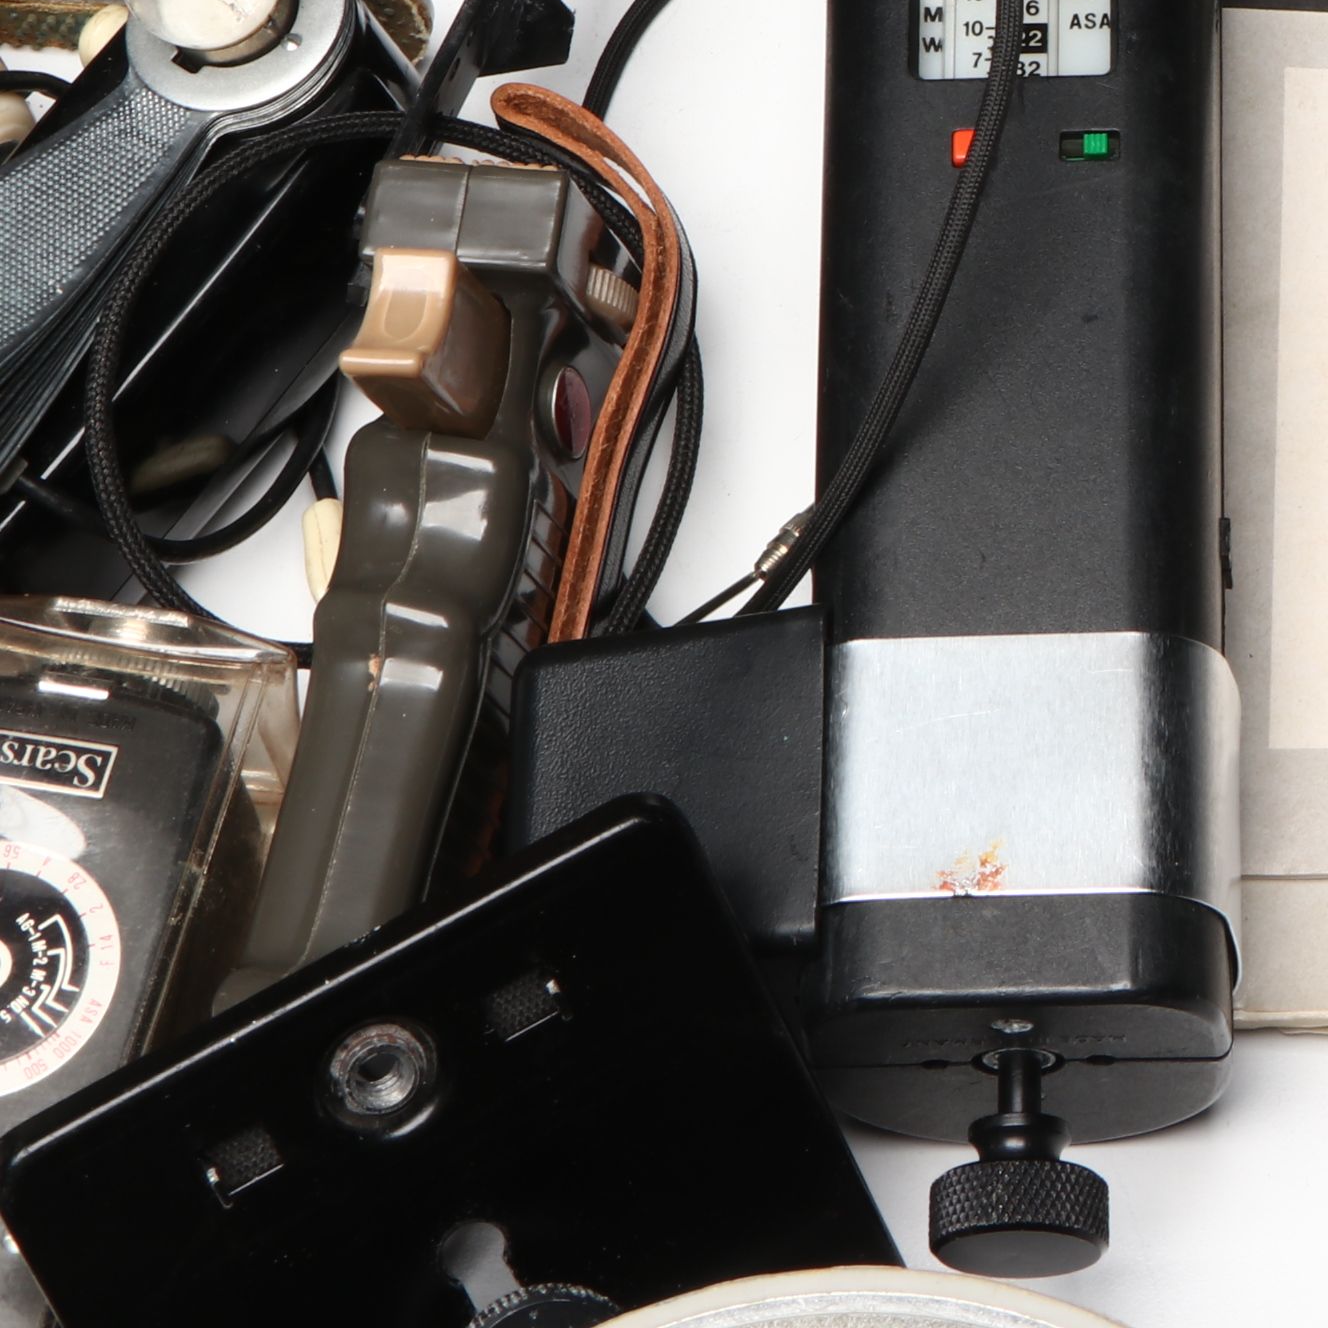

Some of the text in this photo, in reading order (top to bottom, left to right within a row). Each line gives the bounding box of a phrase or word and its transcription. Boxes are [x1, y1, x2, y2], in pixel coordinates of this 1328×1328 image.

[963, 20, 984, 37] 10
[1069, 13, 1111, 30] ASA
[972, 52, 983, 68] 7
[0, 740, 103, 788] Sears
